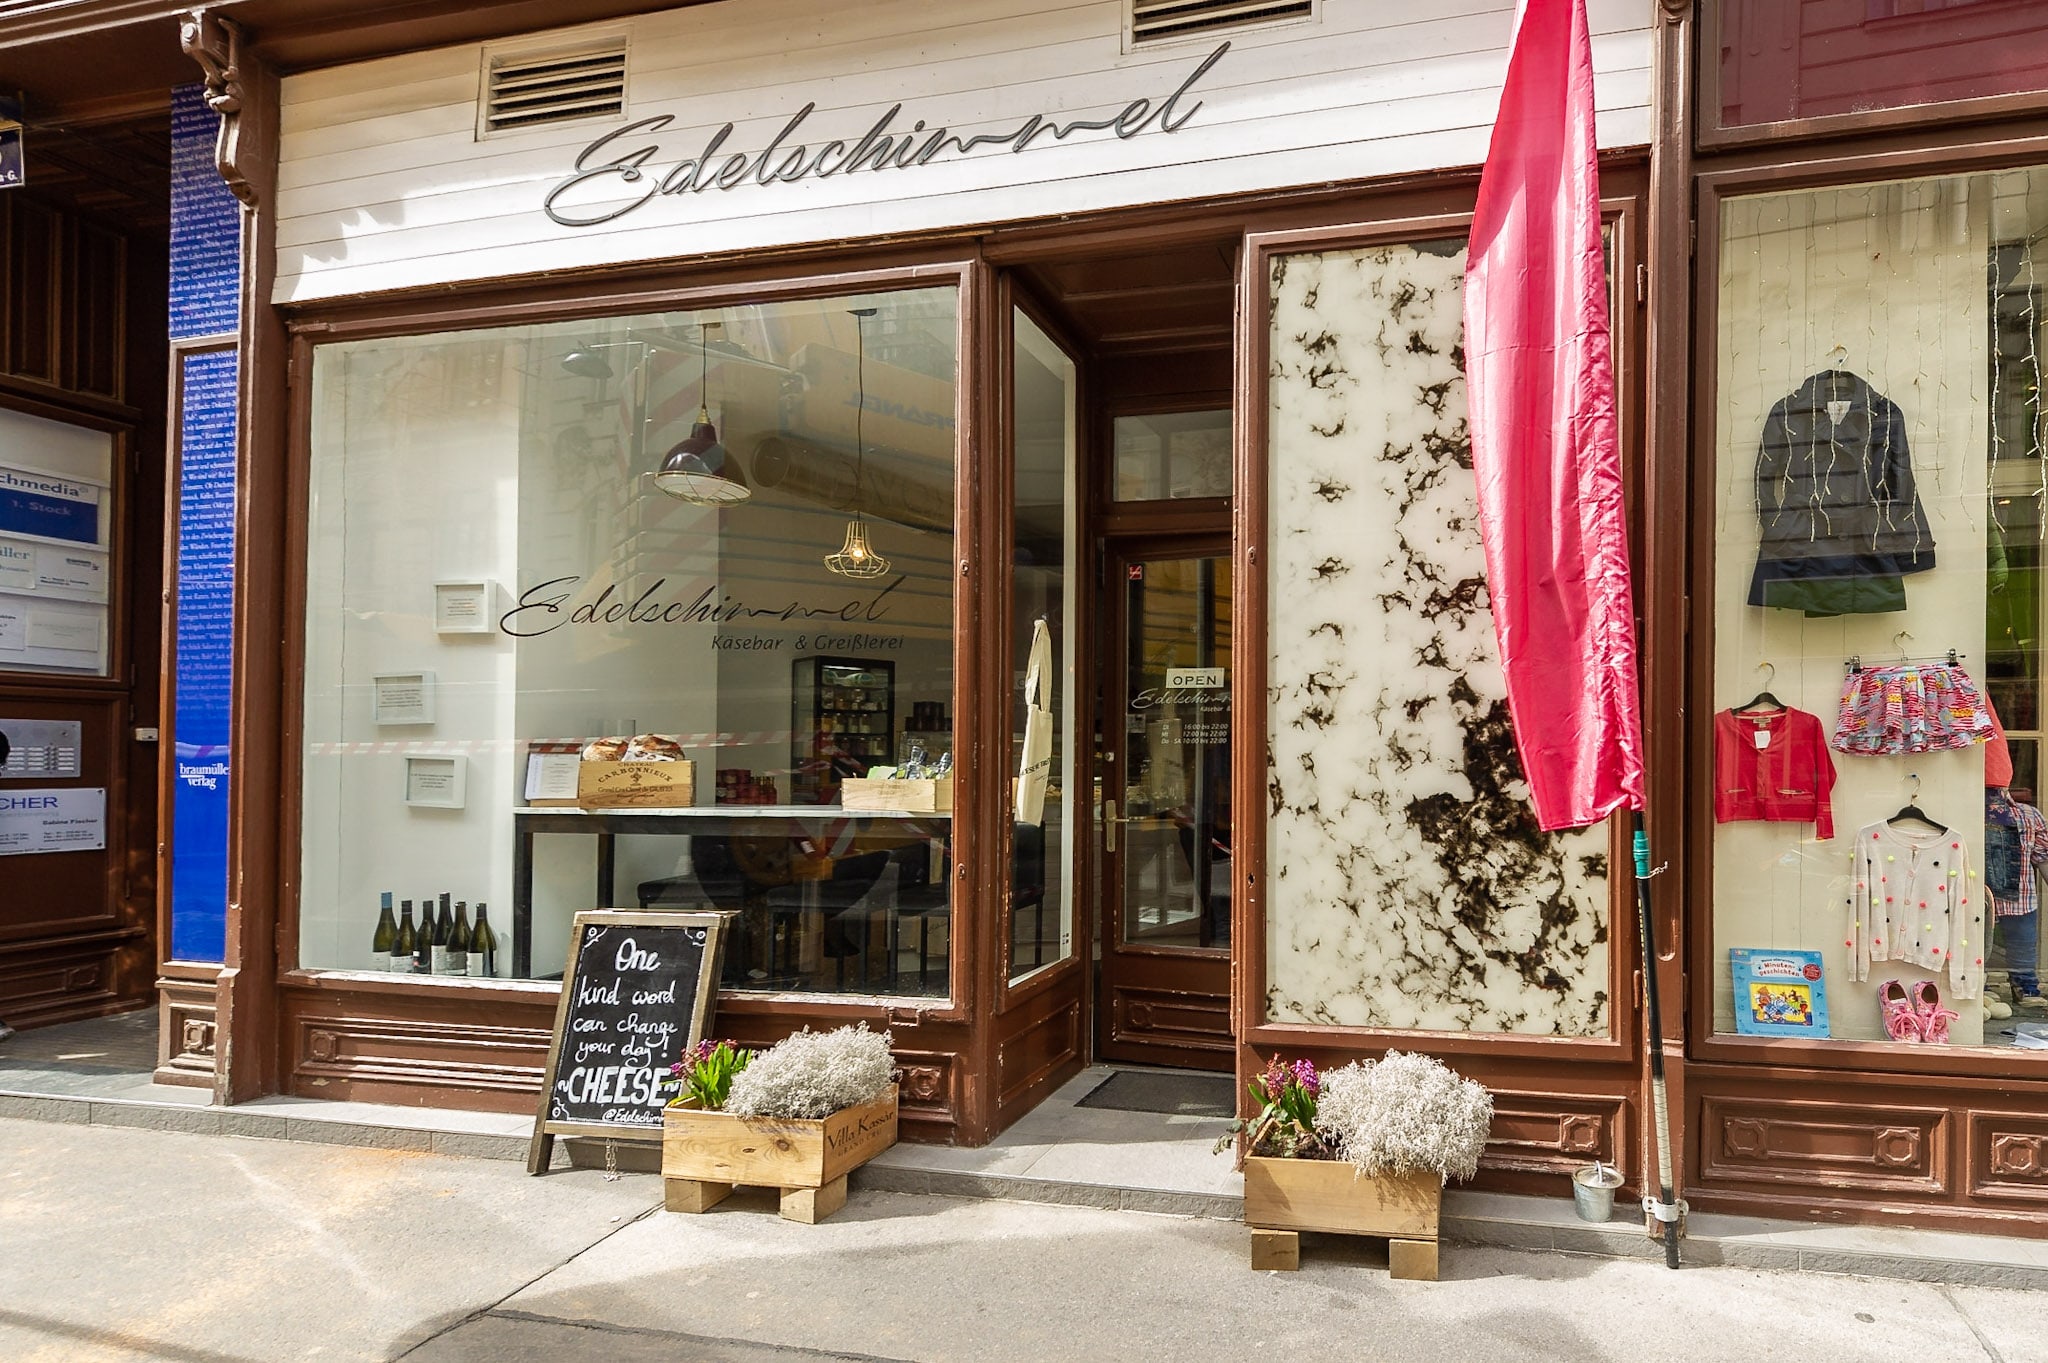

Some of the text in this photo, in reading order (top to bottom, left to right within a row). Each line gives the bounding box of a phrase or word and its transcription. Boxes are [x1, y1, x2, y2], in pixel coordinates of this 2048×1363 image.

[545, 42, 1230, 227] Edelschimmel
[29, 501, 72, 516] Stock
[500, 576, 906, 637] Edelschimmel
[711, 634, 904, 652] Käsebar & Greißlerei
[1172, 675, 1217, 686] OPEN
[179, 762, 231, 776] braumülle
[598, 767, 673, 783] CARBONNIEUX
[188, 777, 217, 791] verlag
[615, 938, 661, 971] One
[577, 975, 677, 1008] kind word
[572, 1013, 679, 1048] can change
[574, 1041, 616, 1063] your
[827, 1125, 855, 1150] Villa
